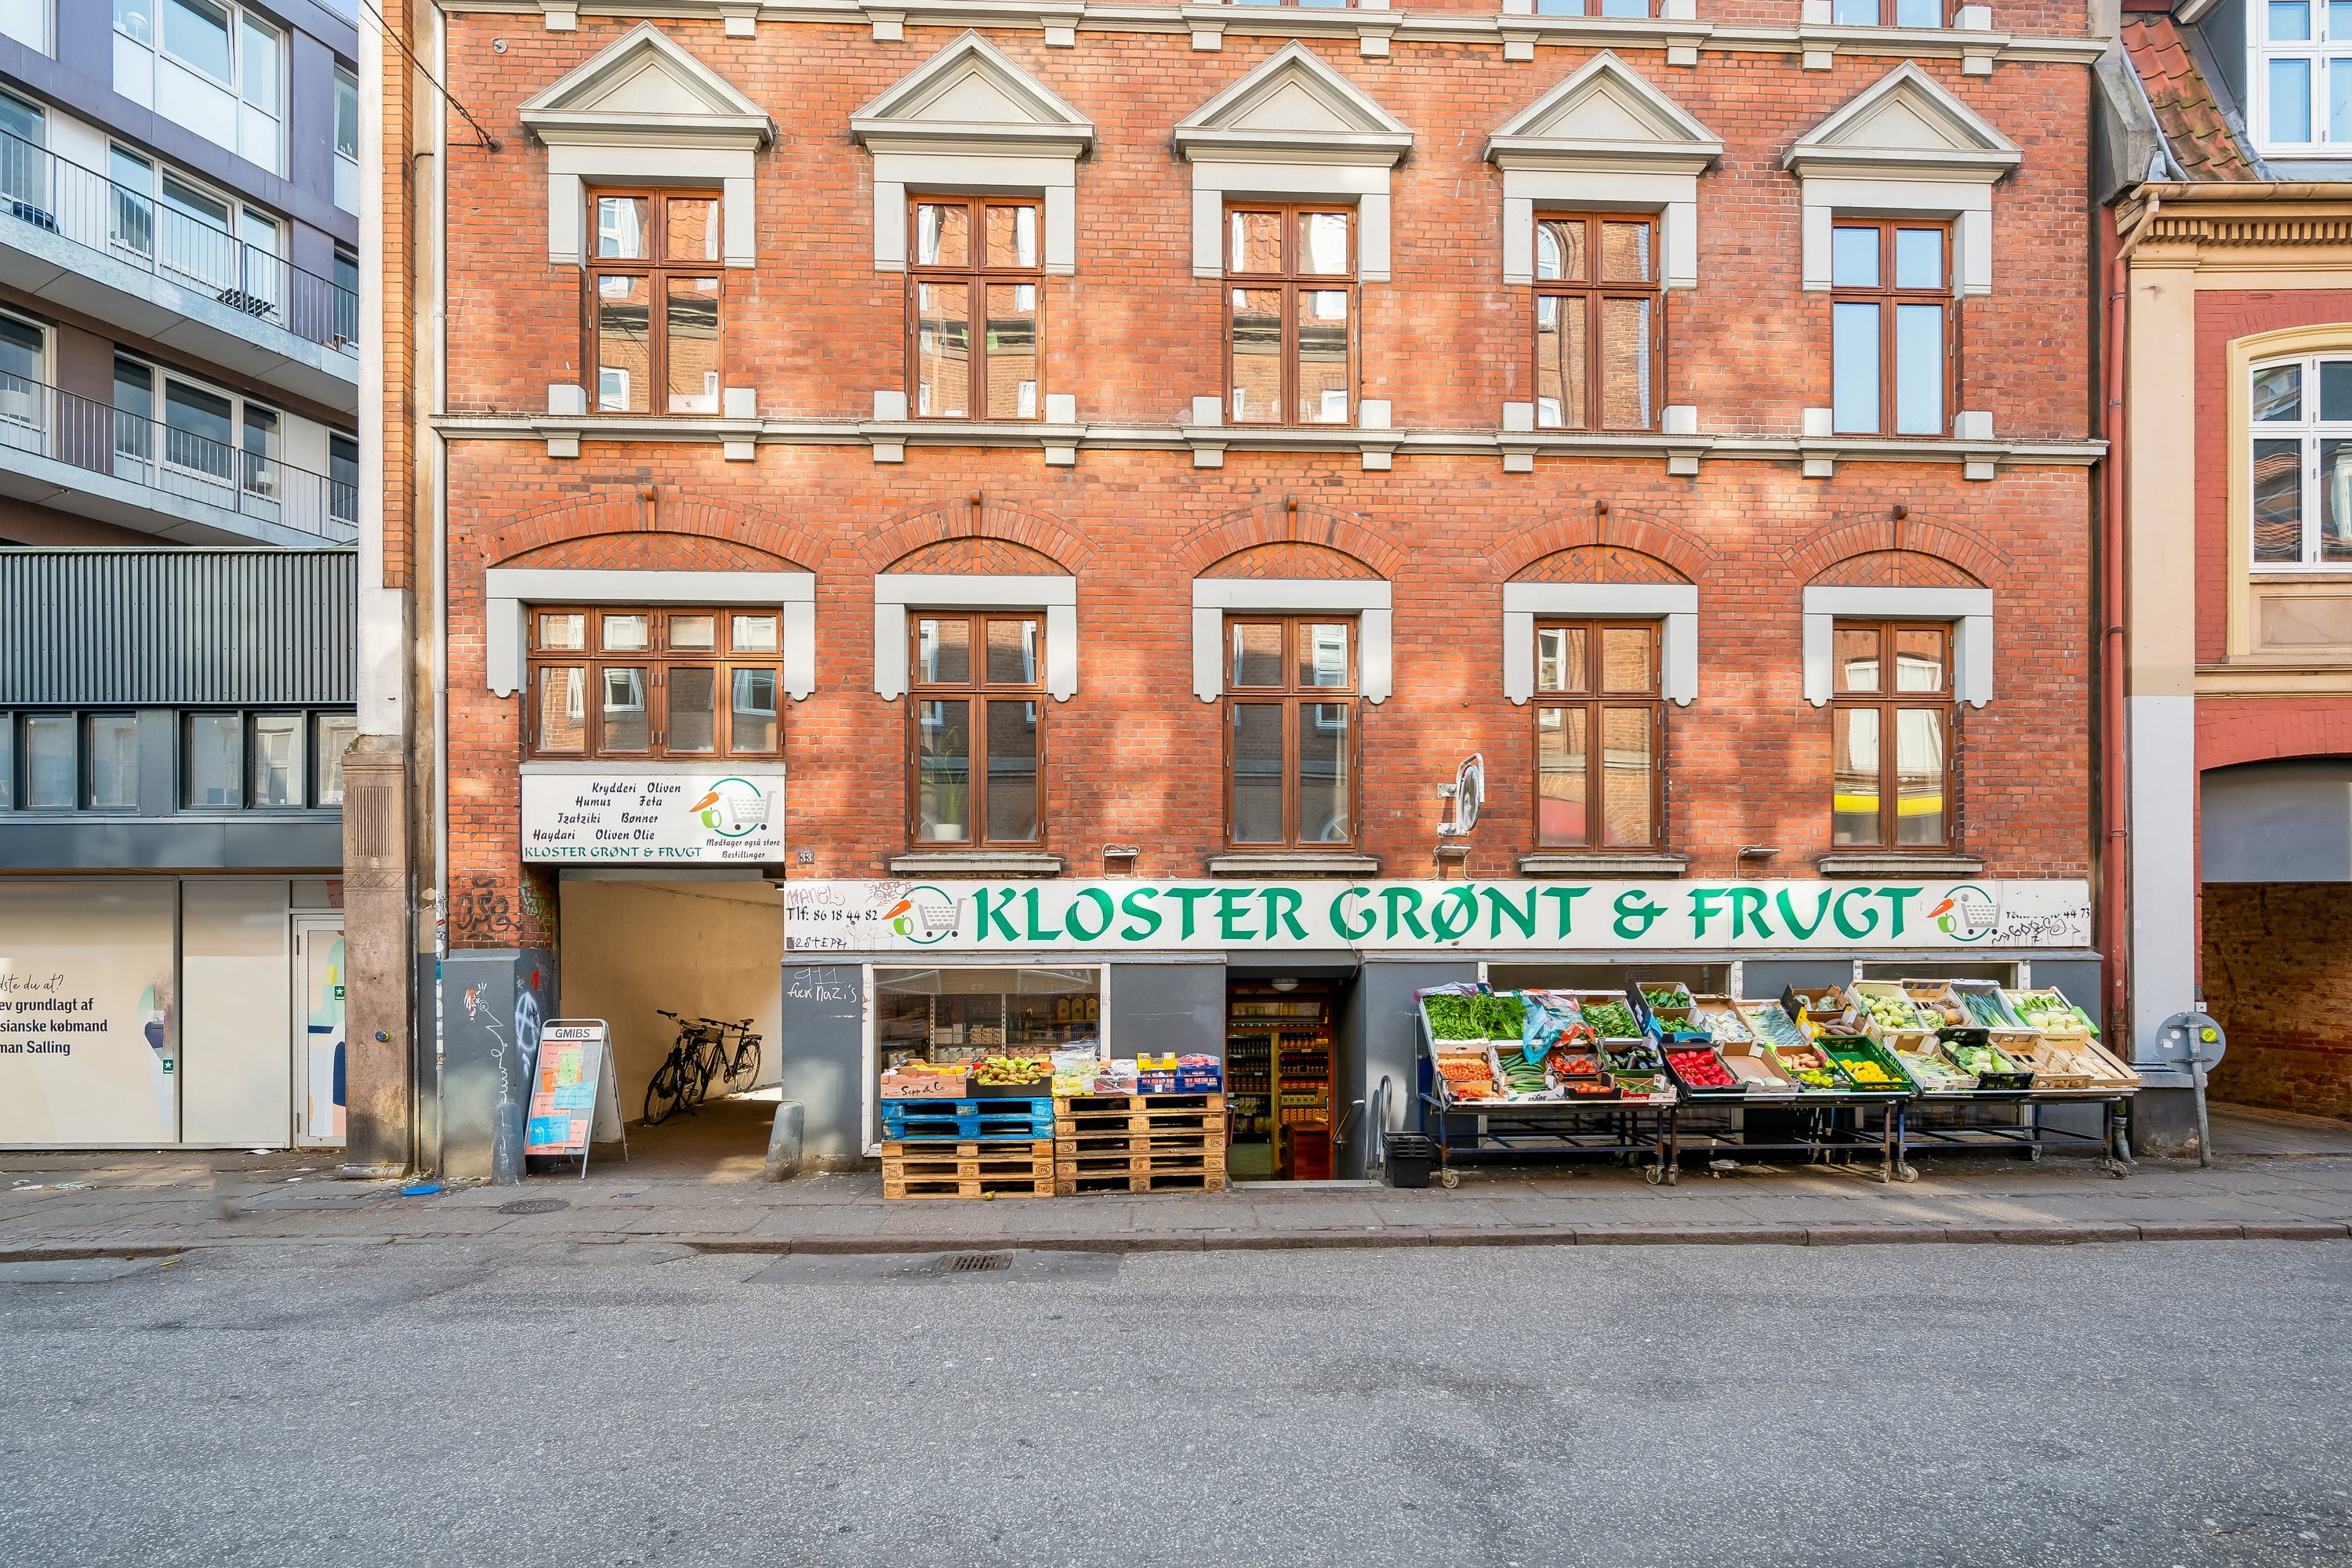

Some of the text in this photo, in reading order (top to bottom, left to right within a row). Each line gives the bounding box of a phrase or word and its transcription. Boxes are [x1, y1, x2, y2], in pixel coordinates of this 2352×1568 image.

[592, 782, 681, 796] Krydderi Oliven
[575, 796, 662, 807] Humus Feta
[557, 813, 659, 825] Tzatziki Bønner
[533, 829, 655, 842] Haydari Oliven Olie
[706, 838, 742, 848] Modtager
[744, 838, 761, 848] også
[524, 846, 703, 858] KLOSTER GRØNT & FRUGT
[721, 851, 765, 860] Bestillinger
[799, 852, 813, 862] 33
[786, 906, 877, 921] Tlf: 86 18 44 82
[972, 884, 1924, 944] KLOSTER GRØNT & FRUGT
[2063, 909, 2077, 919] 44
[2081, 907, 2090, 919] 73
[24, 974, 41, 990] du
[43, 973, 64, 993] at?
[16, 998, 78, 1014] grundlagt
[81, 998, 94, 1011] af
[0, 1019, 108, 1032] sianske købmand
[555, 1029, 590, 1038] GMIBS
[27, 1040, 71, 1056] Salling
[901, 1085, 920, 1096] Sepp
